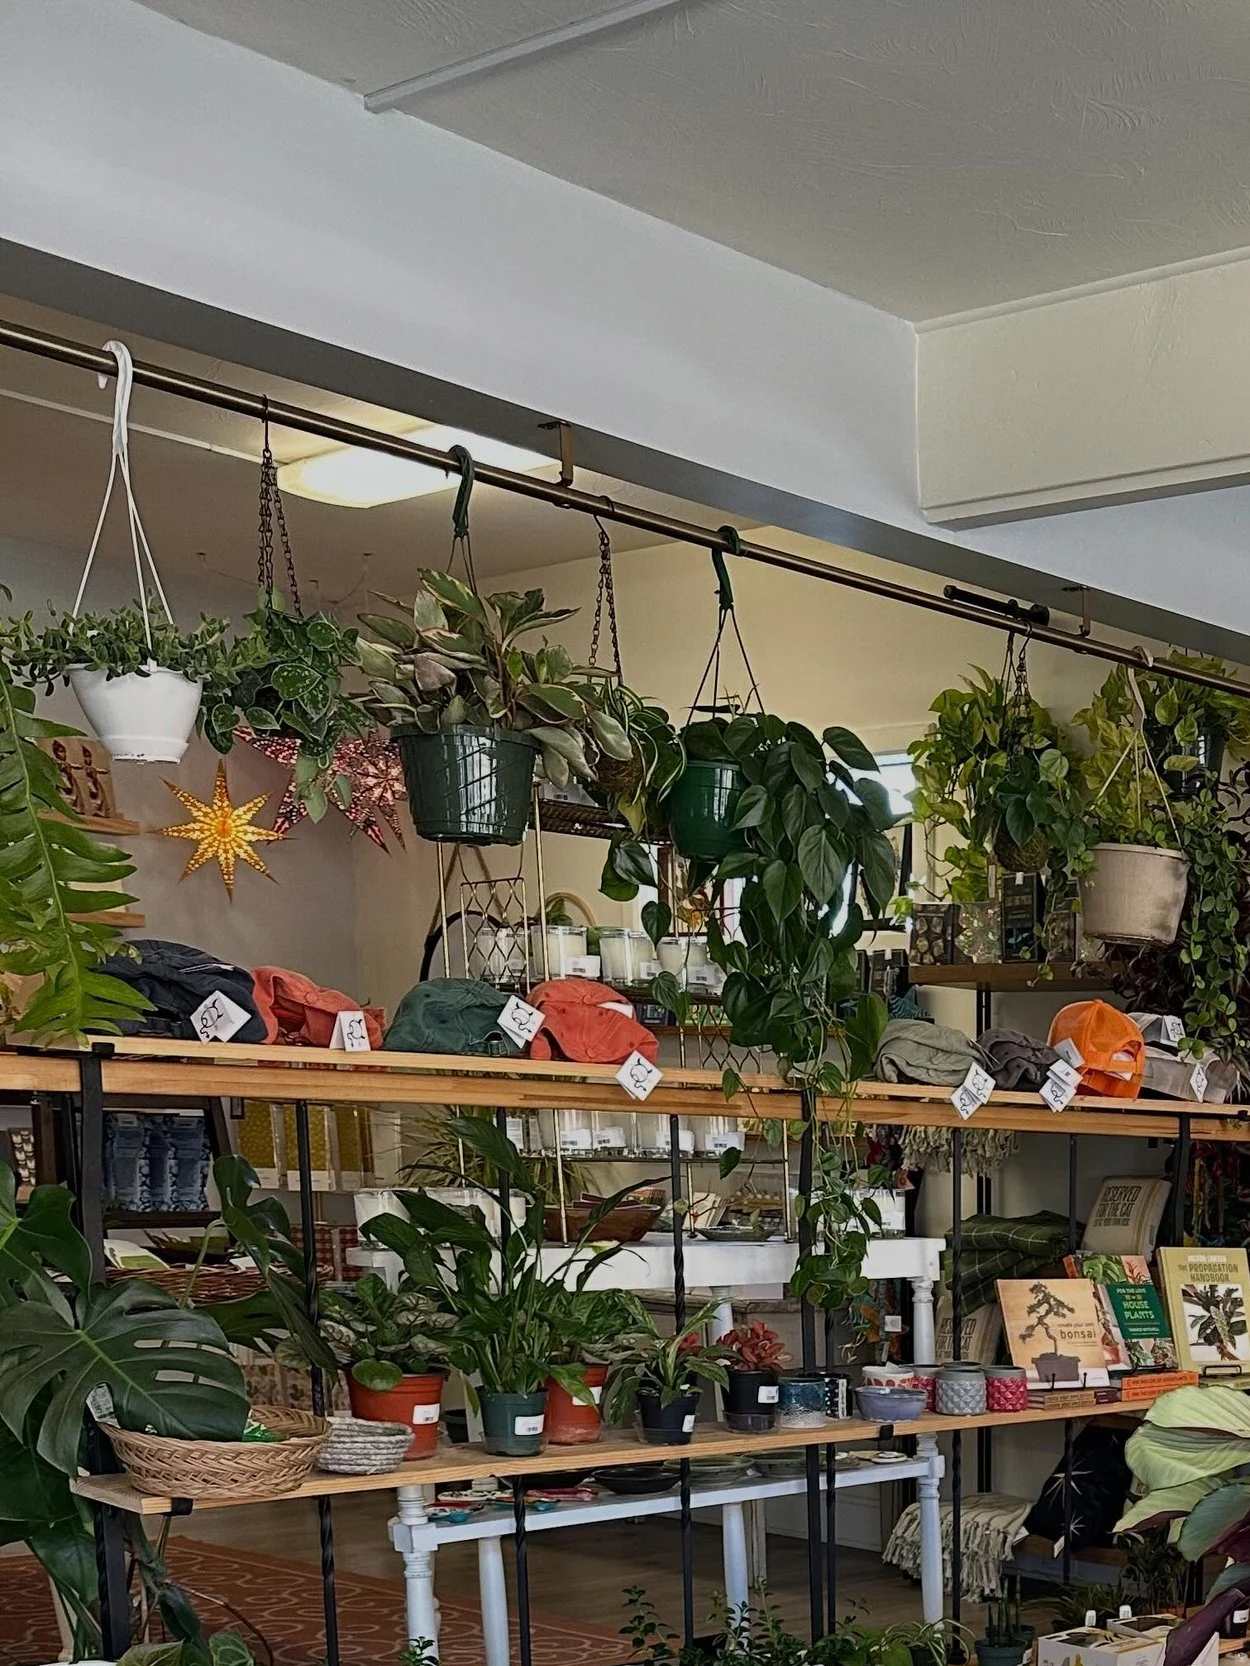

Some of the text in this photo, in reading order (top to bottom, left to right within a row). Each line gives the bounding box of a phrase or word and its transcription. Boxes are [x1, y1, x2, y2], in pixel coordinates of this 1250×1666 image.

[1102, 1185, 1142, 1202] RESERVED
[1189, 1263, 1239, 1273] PROPAGATION
[1190, 1273, 1230, 1282] HANDBOOK
[1122, 1300, 1150, 1309] HOUSE
[1124, 1310, 1155, 1319] PLANTS
[1059, 1329, 1096, 1339] bonsai
